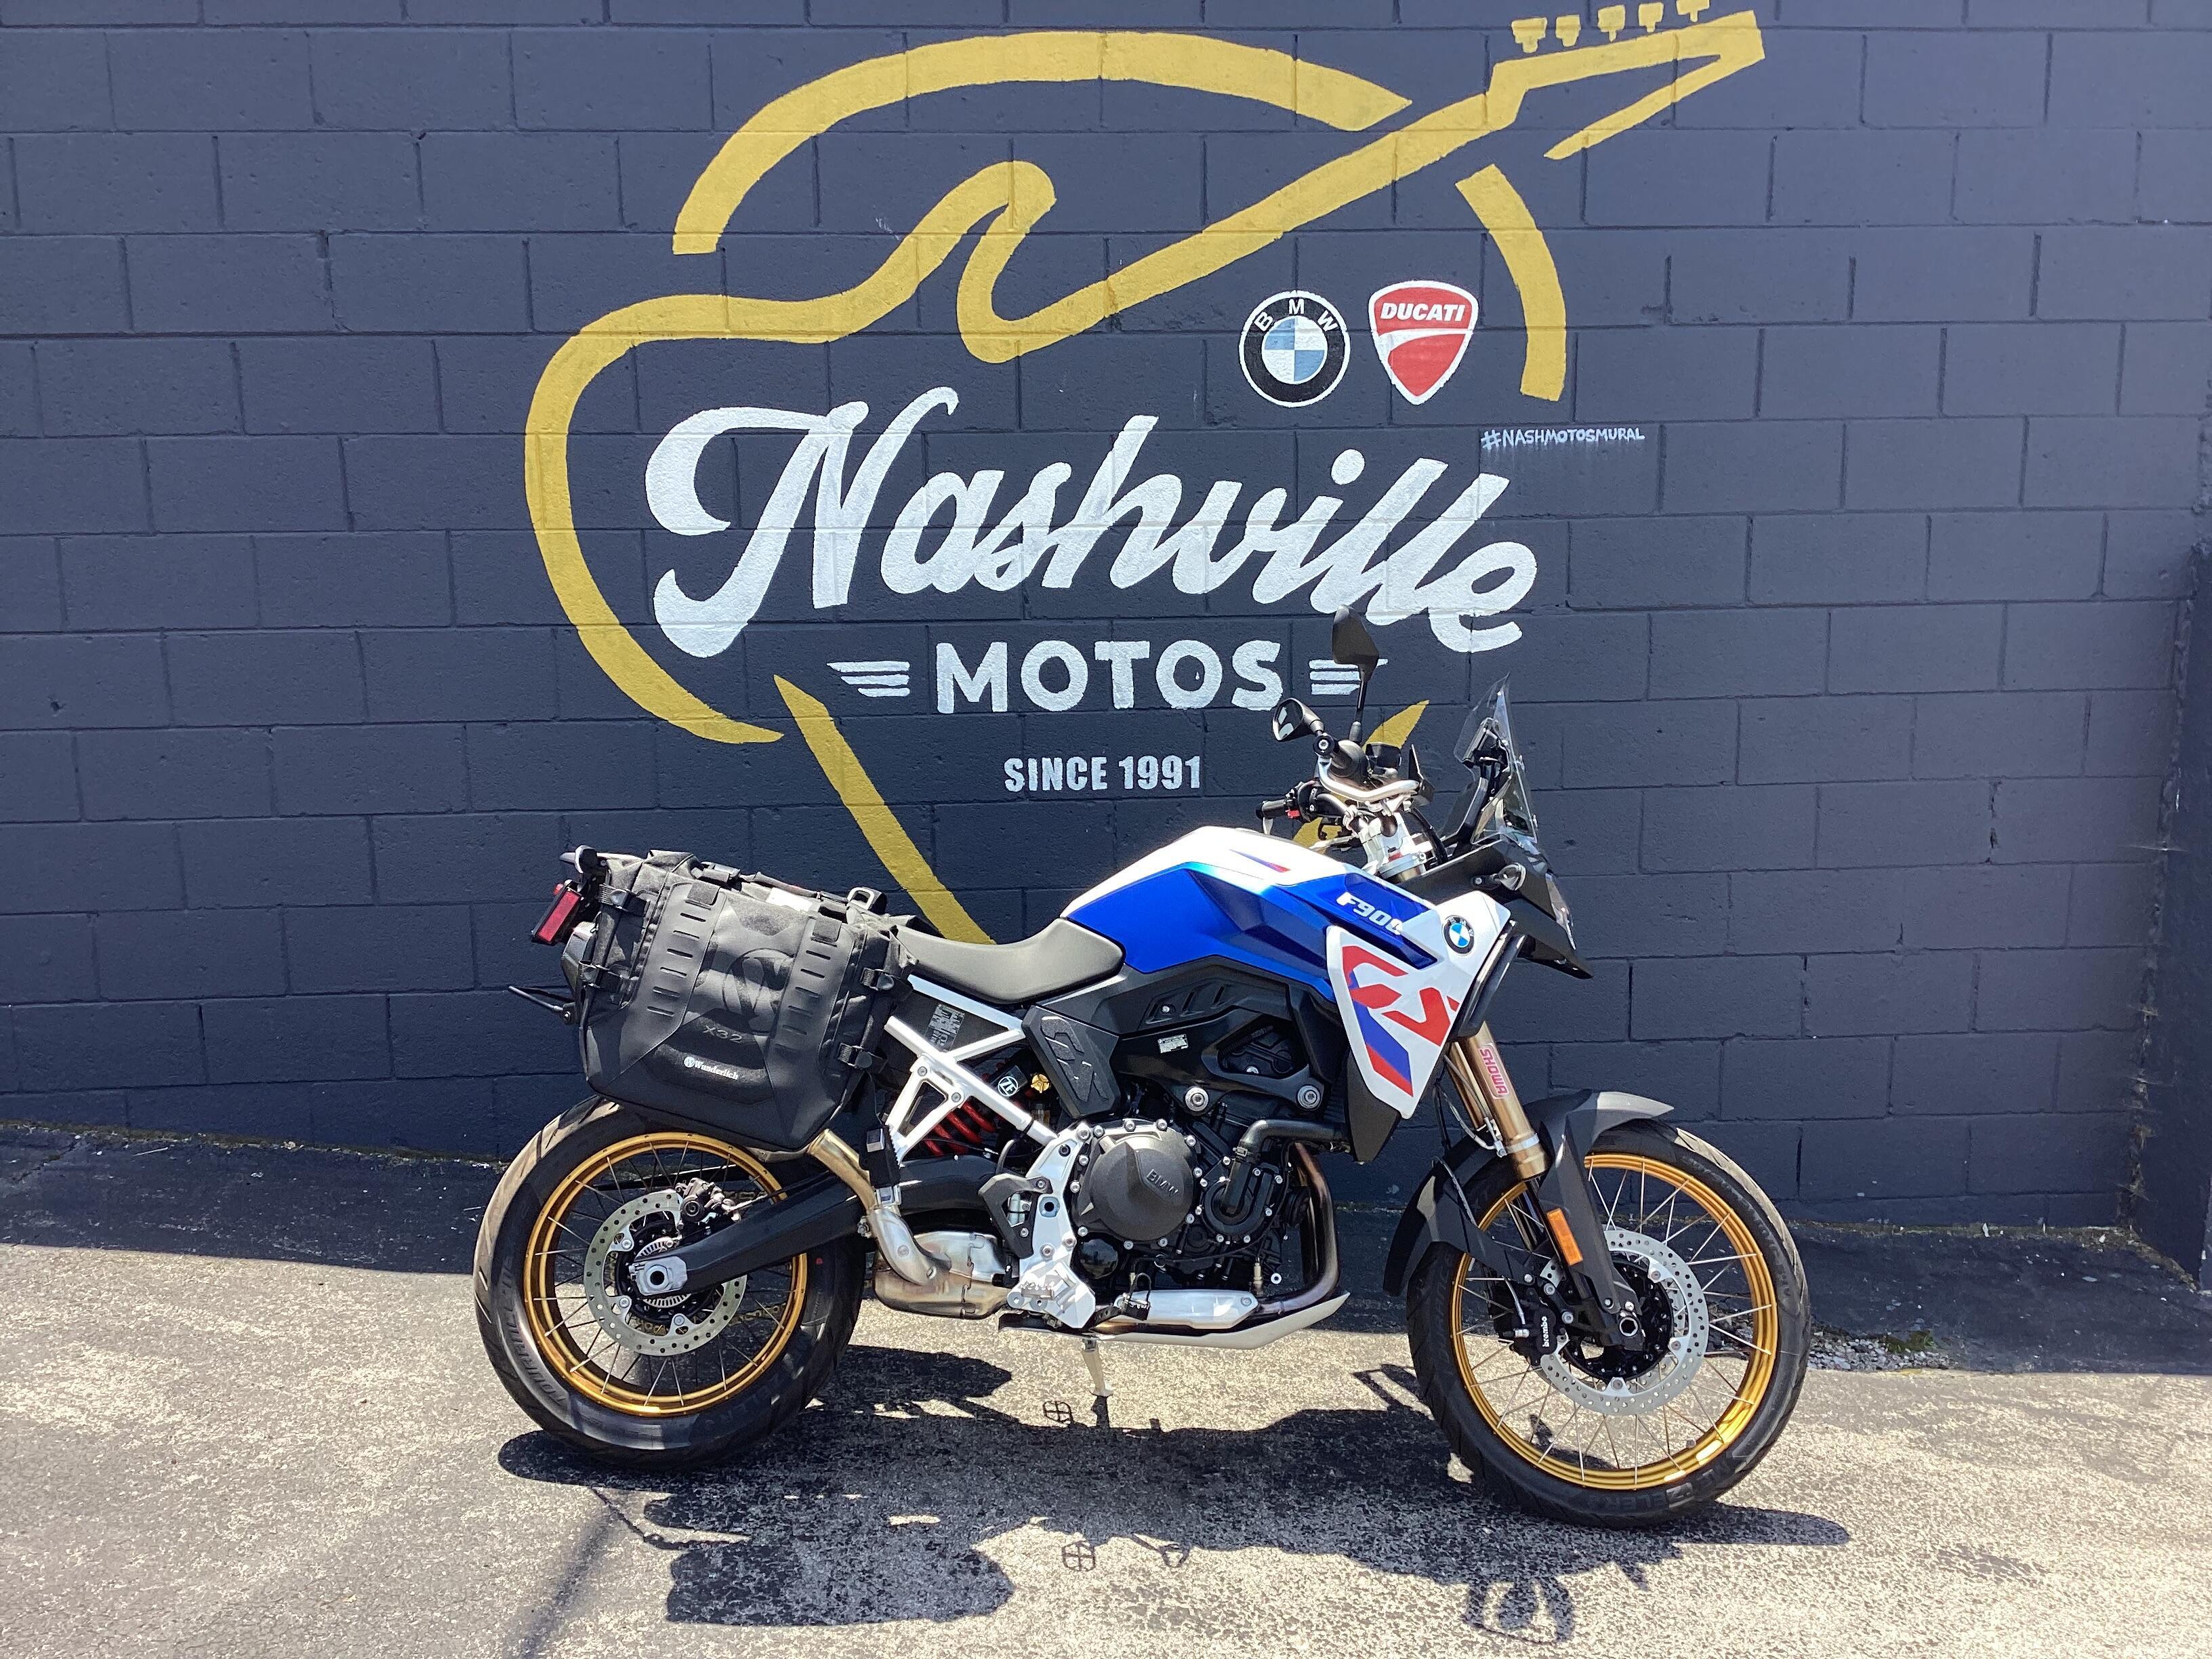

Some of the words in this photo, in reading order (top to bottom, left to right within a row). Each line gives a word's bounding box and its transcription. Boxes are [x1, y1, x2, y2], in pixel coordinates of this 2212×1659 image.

[1254, 298, 1338, 331] BMW
[1380, 302, 1466, 322] DUCATI
[1481, 426, 1645, 450] #NASHMOTOSMURAL
[645, 387, 1537, 657] Nashville
[937, 640, 1284, 714] MOTOS
[1004, 756, 1108, 792] SINCE
[1118, 755, 1201, 790] 1991
[703, 1025, 742, 1044] X32
[1479, 1048, 1509, 1094] SHOWA
[1146, 1168, 1179, 1197] BMW
[1541, 1316, 1550, 1347] brembo
